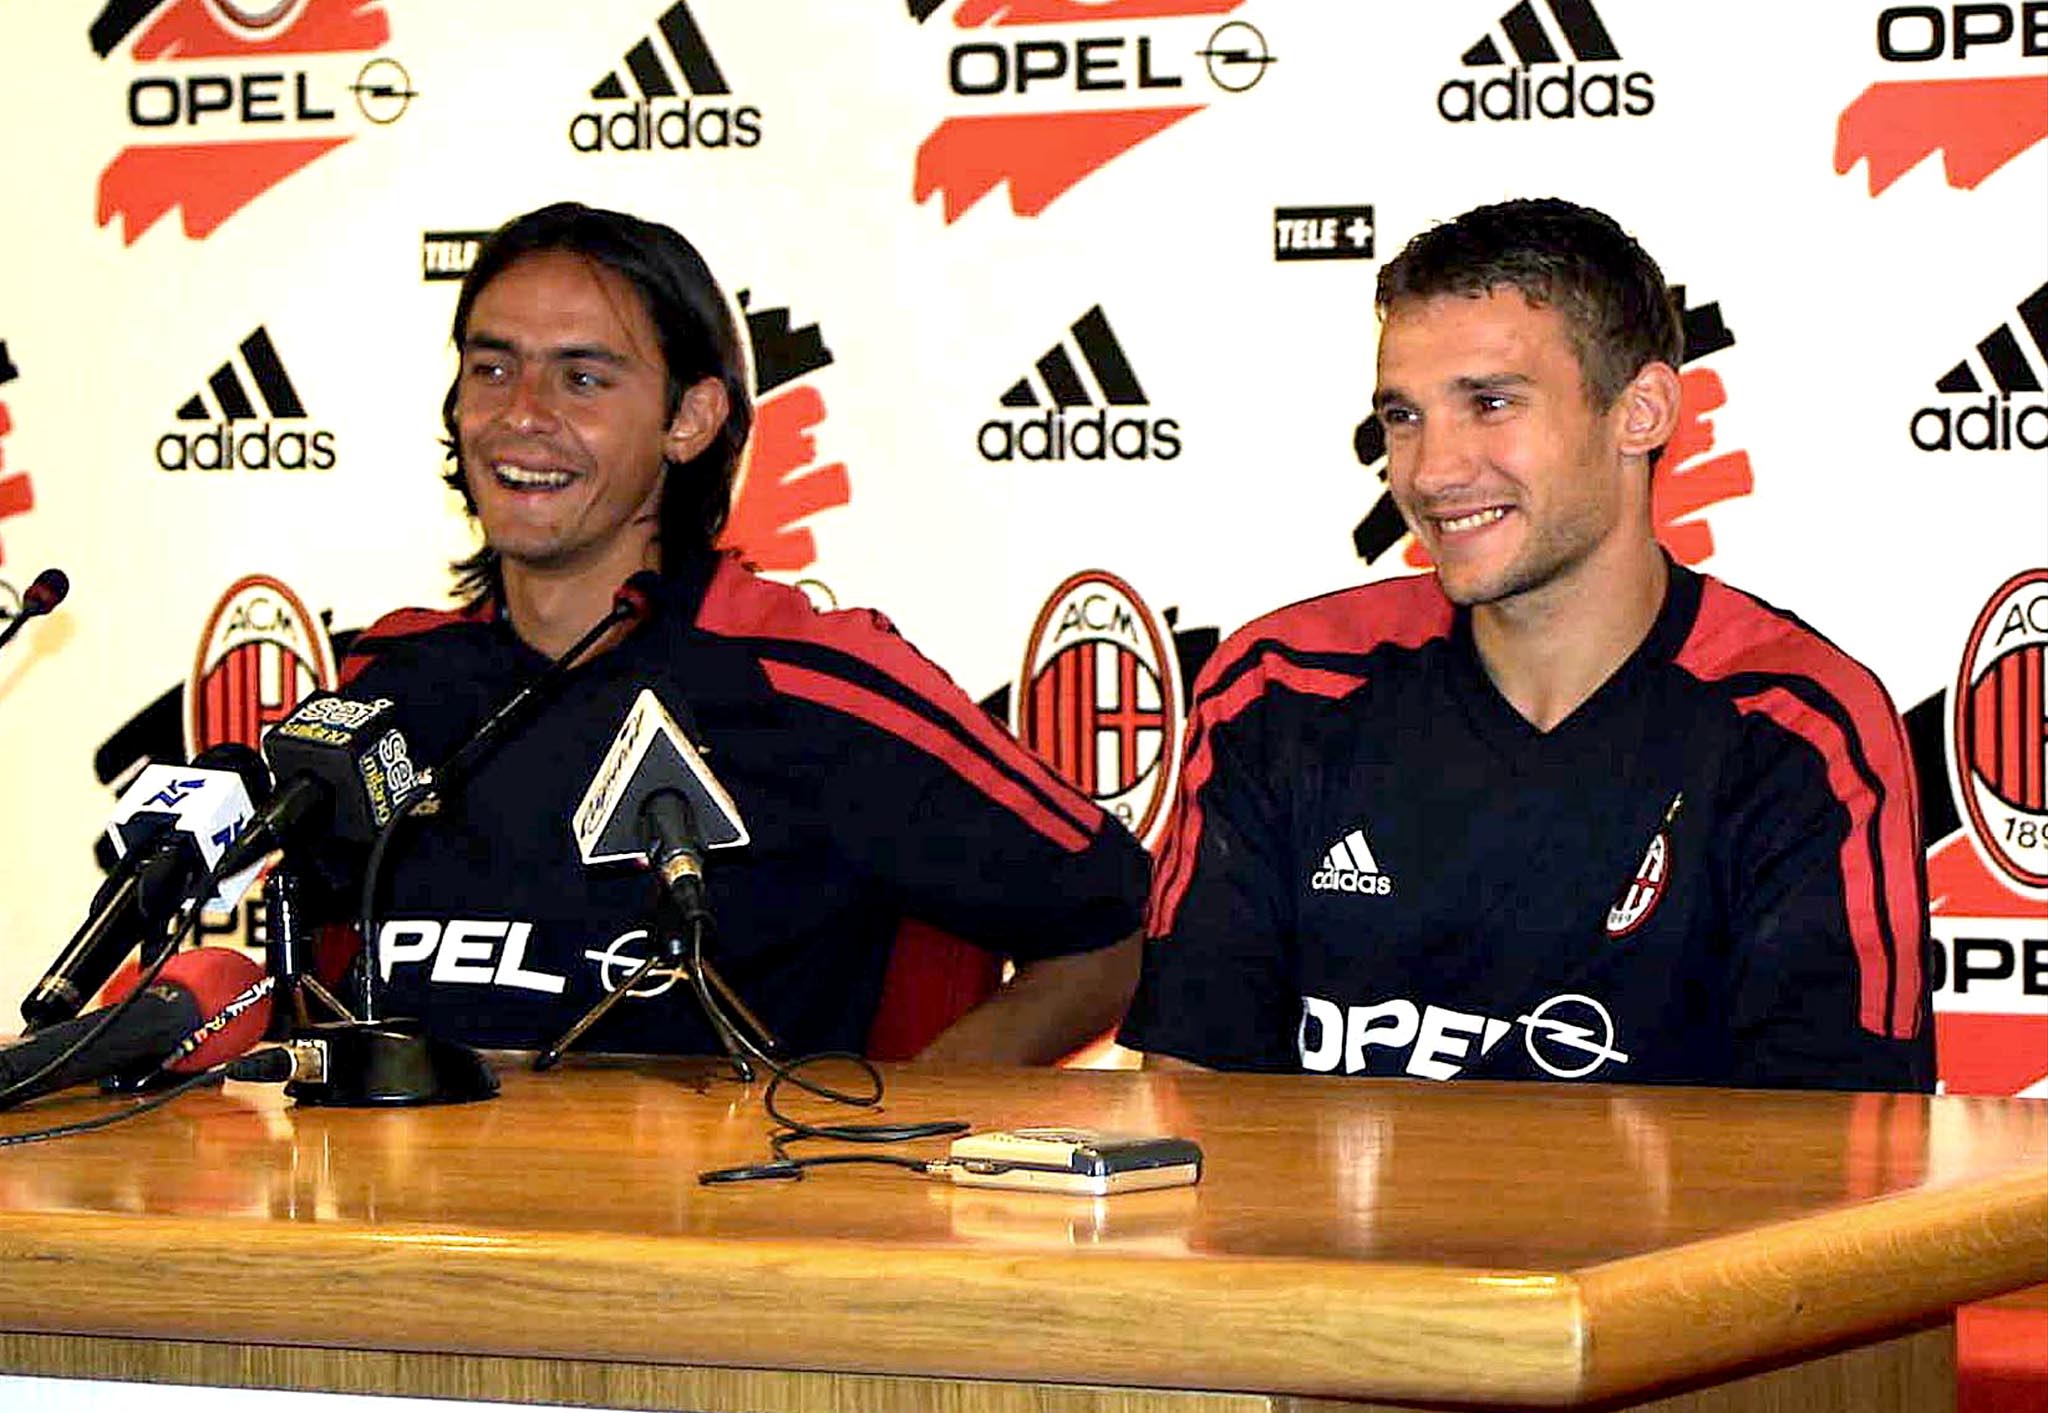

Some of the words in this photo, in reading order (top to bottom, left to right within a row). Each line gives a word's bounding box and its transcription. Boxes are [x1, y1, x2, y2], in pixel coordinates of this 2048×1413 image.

[949, 36, 1183, 96] OPEL
[1437, 62, 1655, 122] adidas
[127, 72, 335, 127] OPEL
[569, 97, 761, 152] adidas
[1277, 217, 1338, 249] TELE
[156, 421, 336, 471] adidas
[977, 407, 1182, 461] adidas
[1054, 594, 1138, 643] ACM
[378, 919, 566, 994] PEL
